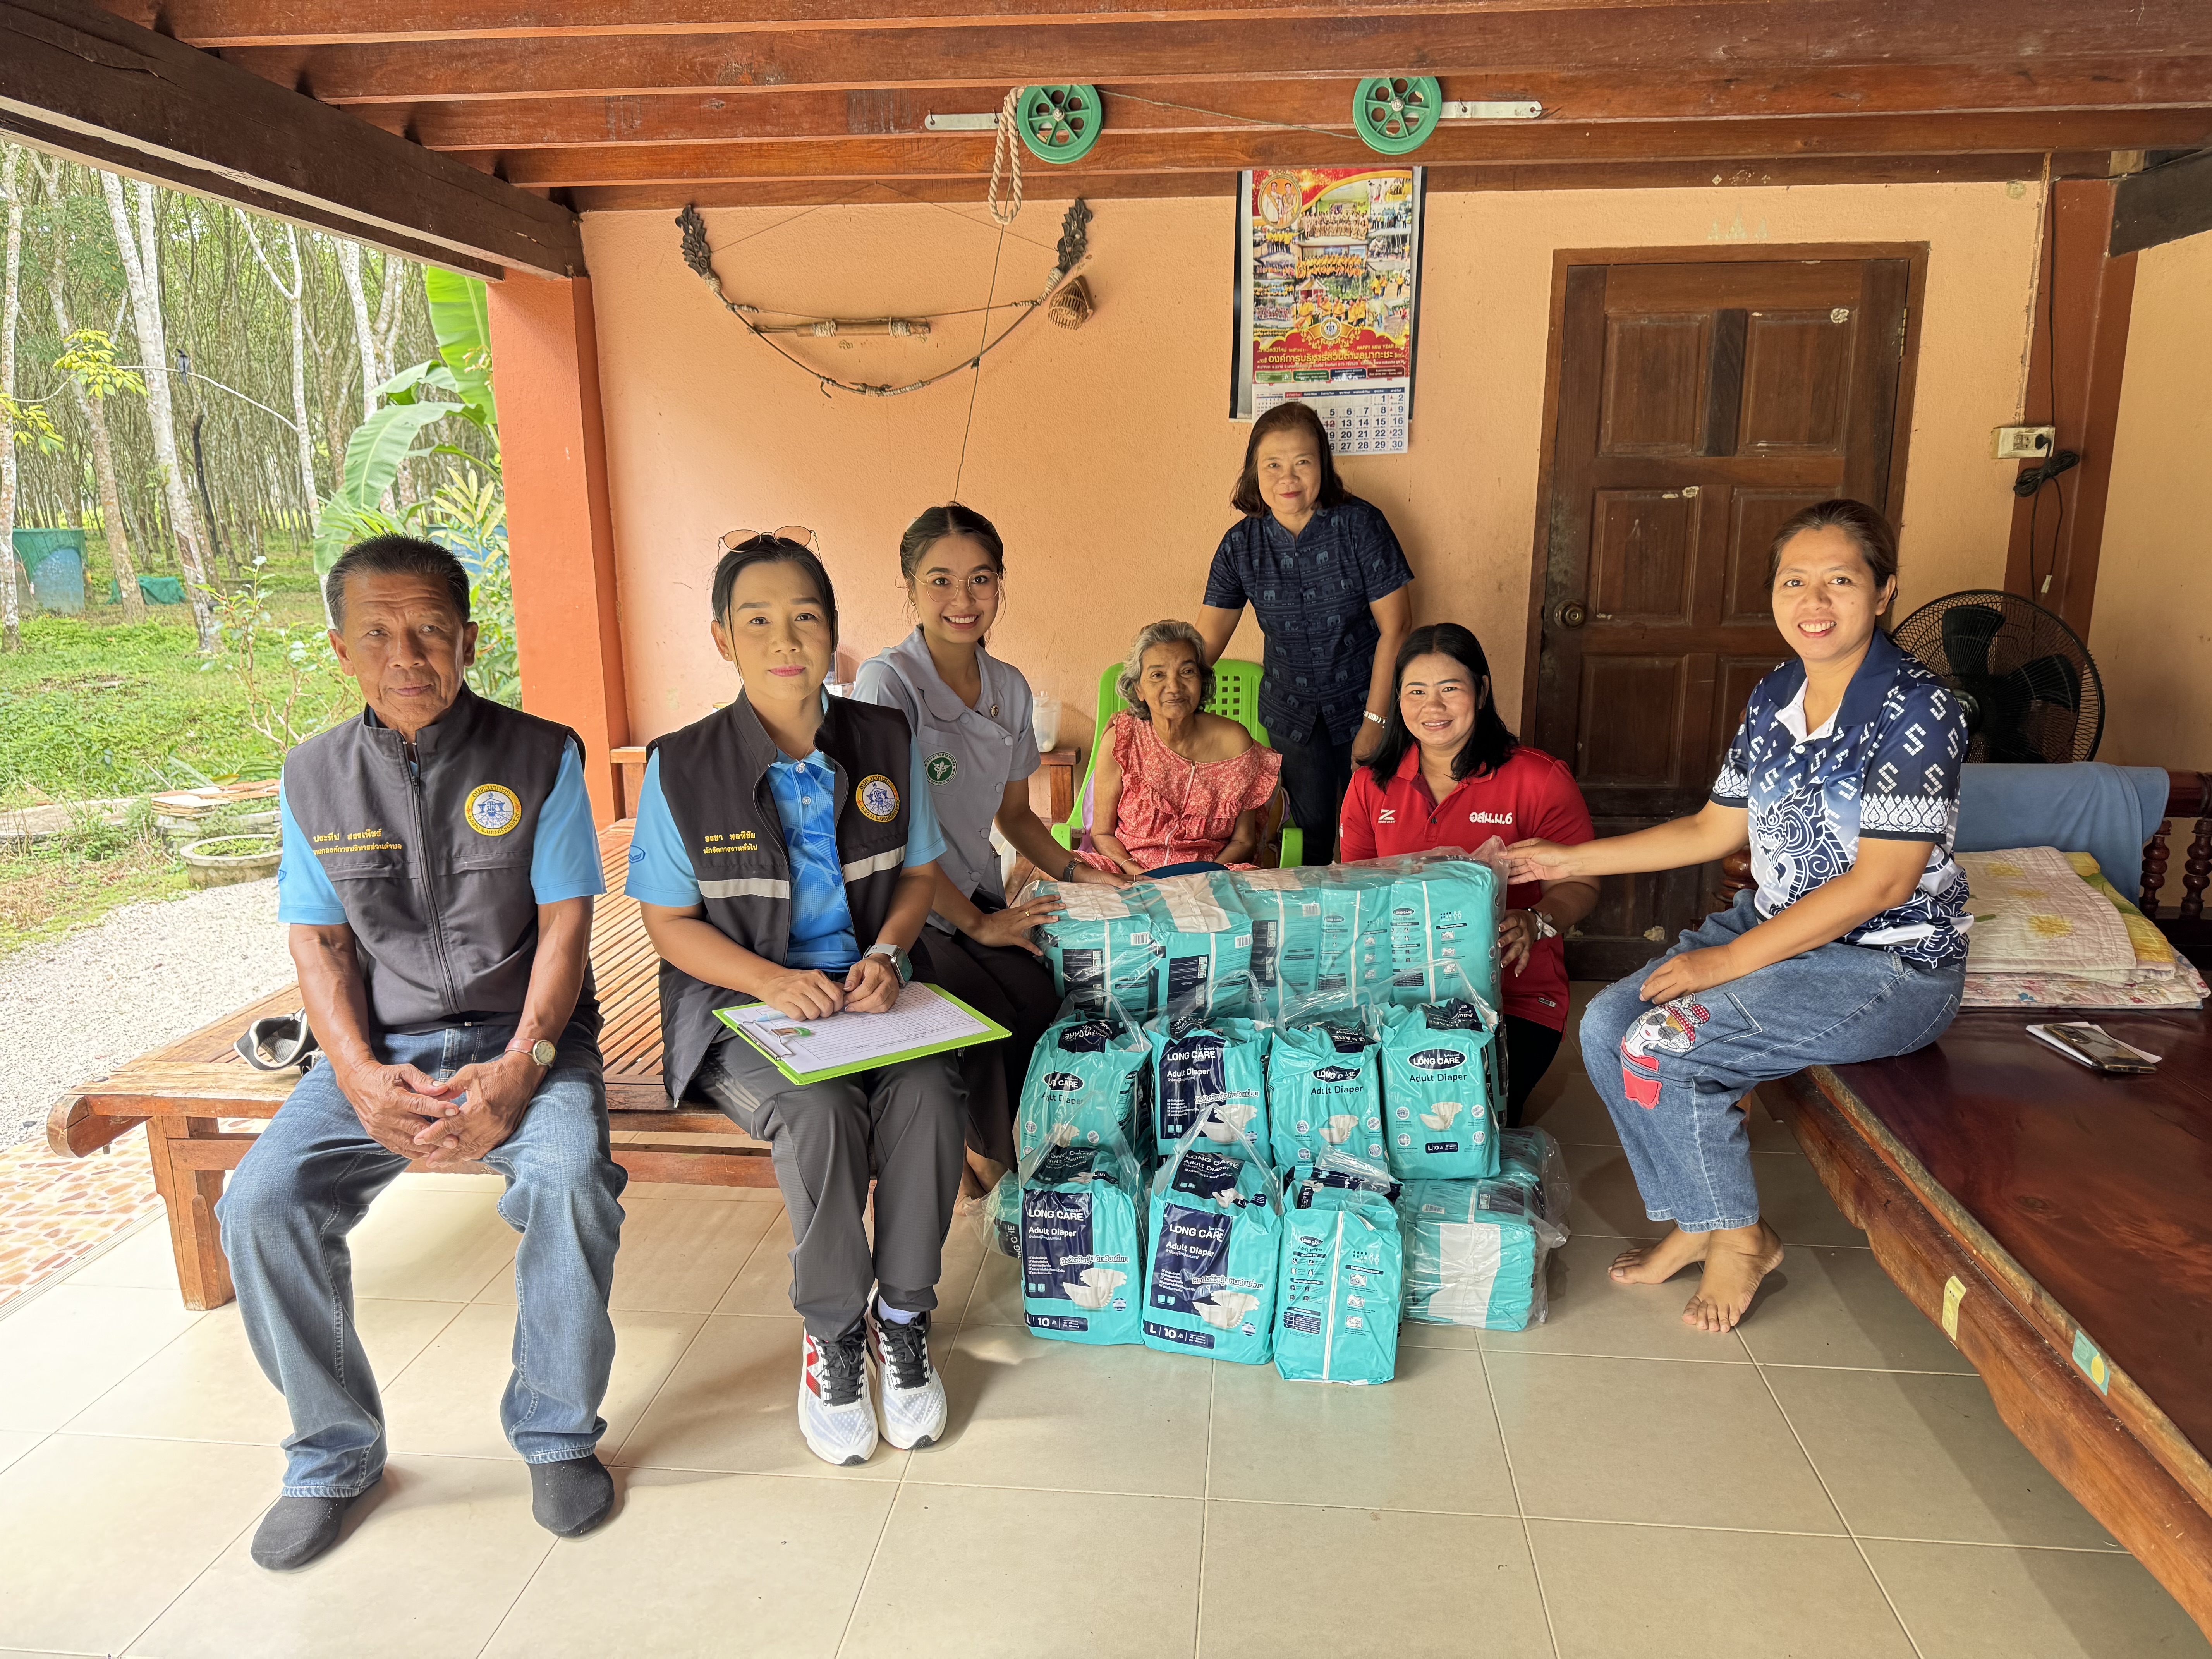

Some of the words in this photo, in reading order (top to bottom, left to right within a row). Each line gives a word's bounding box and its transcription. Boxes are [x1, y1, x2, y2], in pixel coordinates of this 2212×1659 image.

[859, 776, 891, 790] อบต.นากะชะ
[472, 785, 512, 797] อบต.นากะชะ
[1469, 811, 1512, 824] อสม.ม.6
[313, 832, 340, 842] ประทีป
[703, 843, 757, 854] นักจัดการงานทั่วไป
[1167, 1051, 1190, 1061] LONG
[1191, 1051, 1216, 1059] CARE
[1317, 1070, 1336, 1079] LONG
[1437, 1073, 1467, 1082] Diaper
[1058, 1080, 1079, 1088] CARE
[1311, 1086, 1332, 1095] Adult
[1334, 1085, 1364, 1095] Diaper
[1184, 1159, 1204, 1168] Adult
[1186, 1154, 1211, 1163] LONG
[1213, 1159, 1240, 1169] CARE
[1029, 1209, 1054, 1219] LONG
[1056, 1212, 1084, 1221] CARE
[1029, 1226, 1049, 1235] Adult
[1051, 1228, 1077, 1237] Diaper
[1169, 1224, 1197, 1236] LONG
[1198, 1229, 1224, 1242] CARE
[1166, 1241, 1188, 1252] Adult
[1189, 1246, 1214, 1257] Diaper
[1037, 1317, 1050, 1327] 10
[1149, 1324, 1157, 1334] L
[1164, 1328, 1176, 1339] 10
